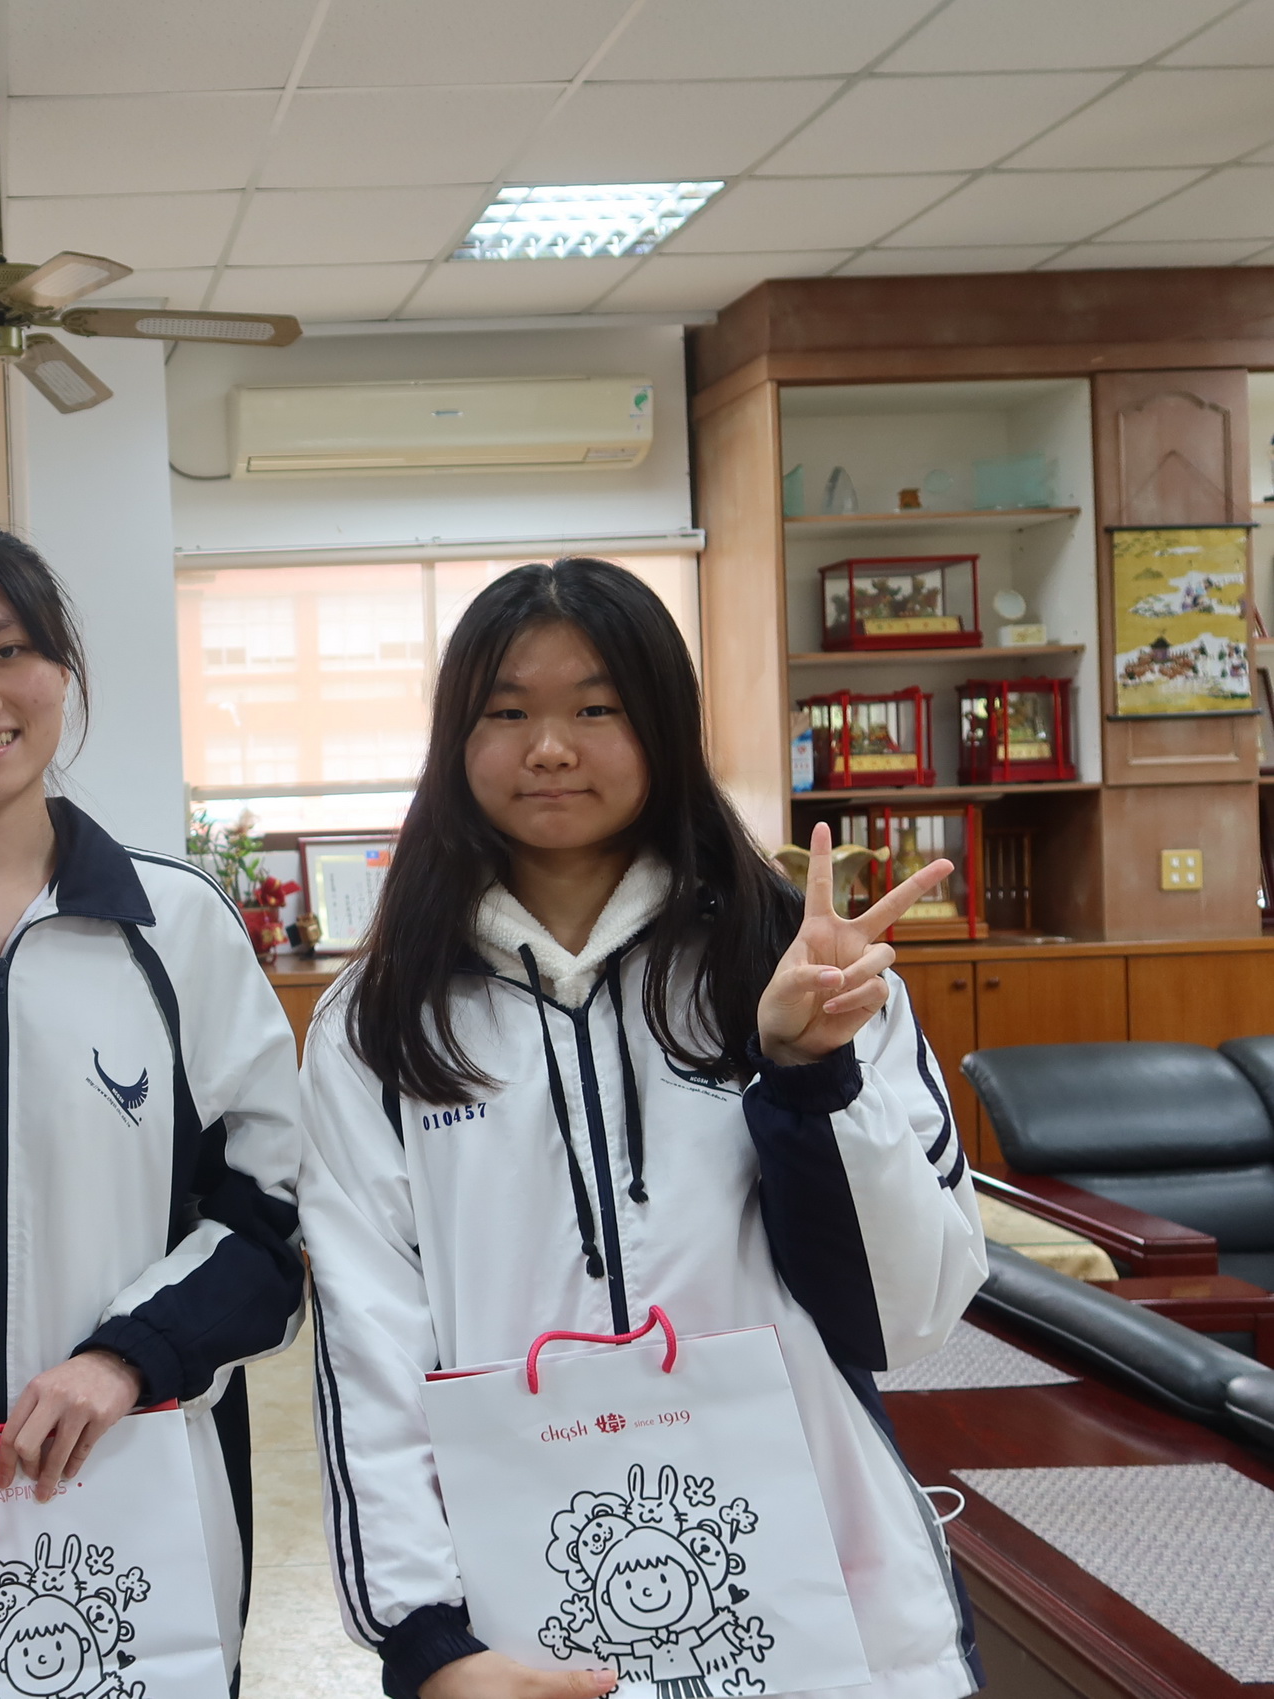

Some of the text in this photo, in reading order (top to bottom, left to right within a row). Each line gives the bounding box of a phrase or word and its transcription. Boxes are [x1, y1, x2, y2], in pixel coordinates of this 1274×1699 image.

[422, 1102, 486, 1131] 010457
[634, 1419, 654, 1428] since
[657, 1409, 690, 1427] 1919
